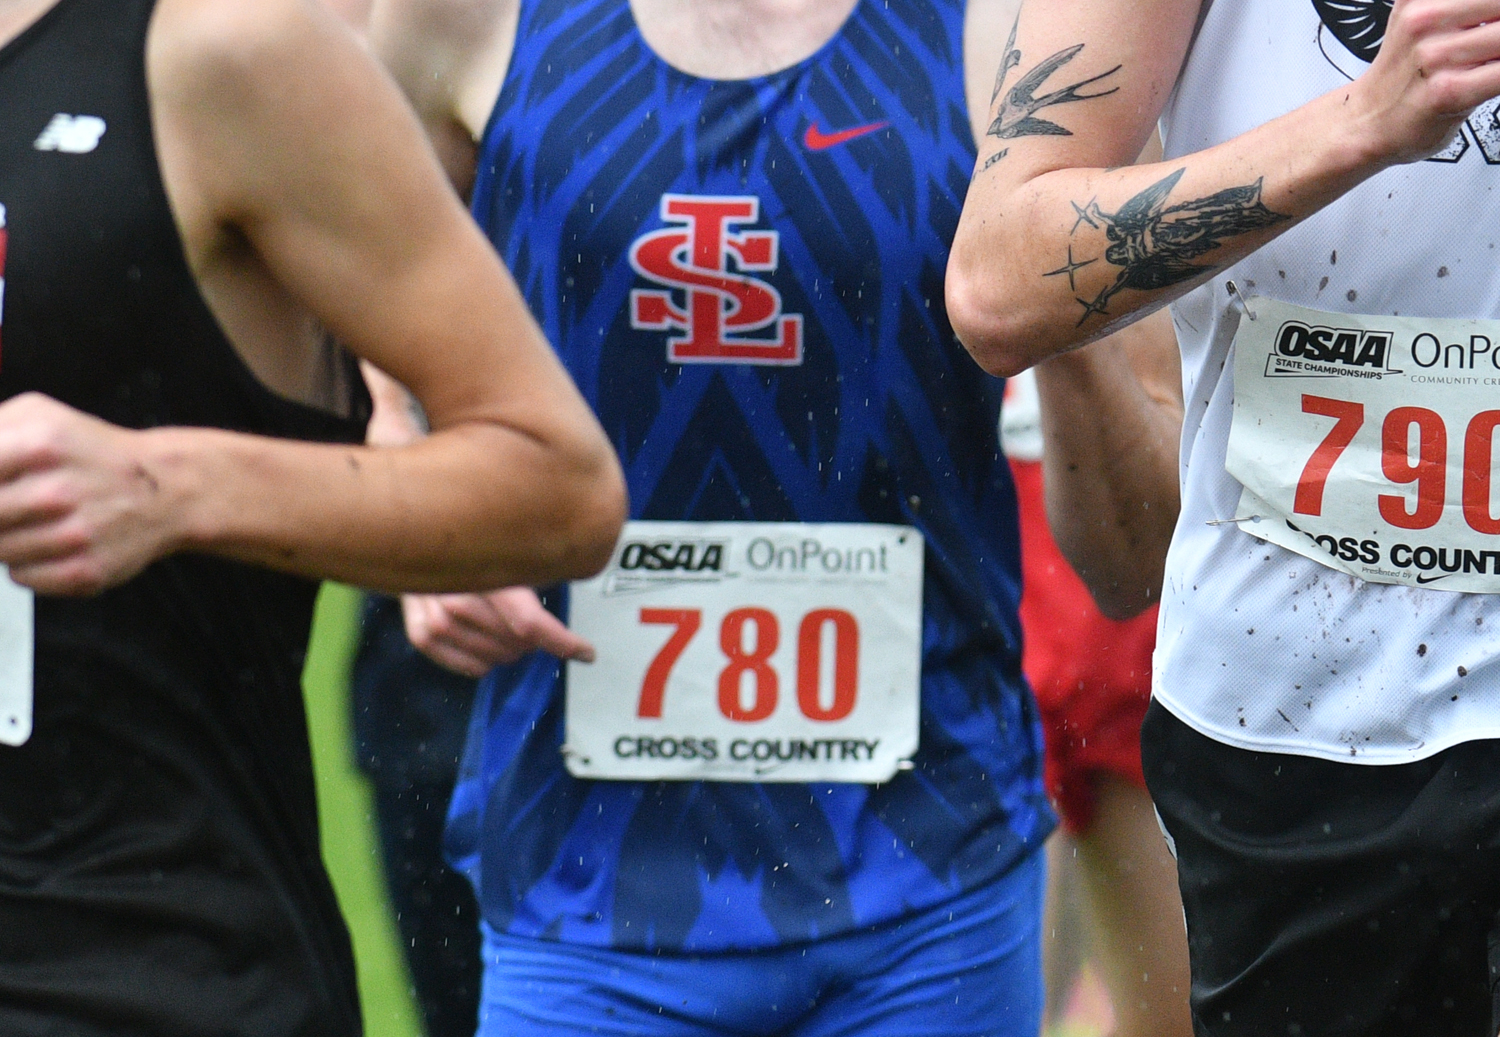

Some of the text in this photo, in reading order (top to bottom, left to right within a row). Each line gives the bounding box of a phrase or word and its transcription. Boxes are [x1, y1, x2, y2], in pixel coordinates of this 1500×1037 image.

[1279, 325, 1386, 368] OSAA
[1275, 358, 1382, 380] STATE CHAMPIONSHIPS
[1410, 375, 1479, 385] COMMUNITY
[619, 536, 887, 573] OSAA OnPoint
[1286, 518, 1380, 565] OSS
[638, 607, 860, 723] 780
[613, 736, 880, 762] CROSS COUNTRY
